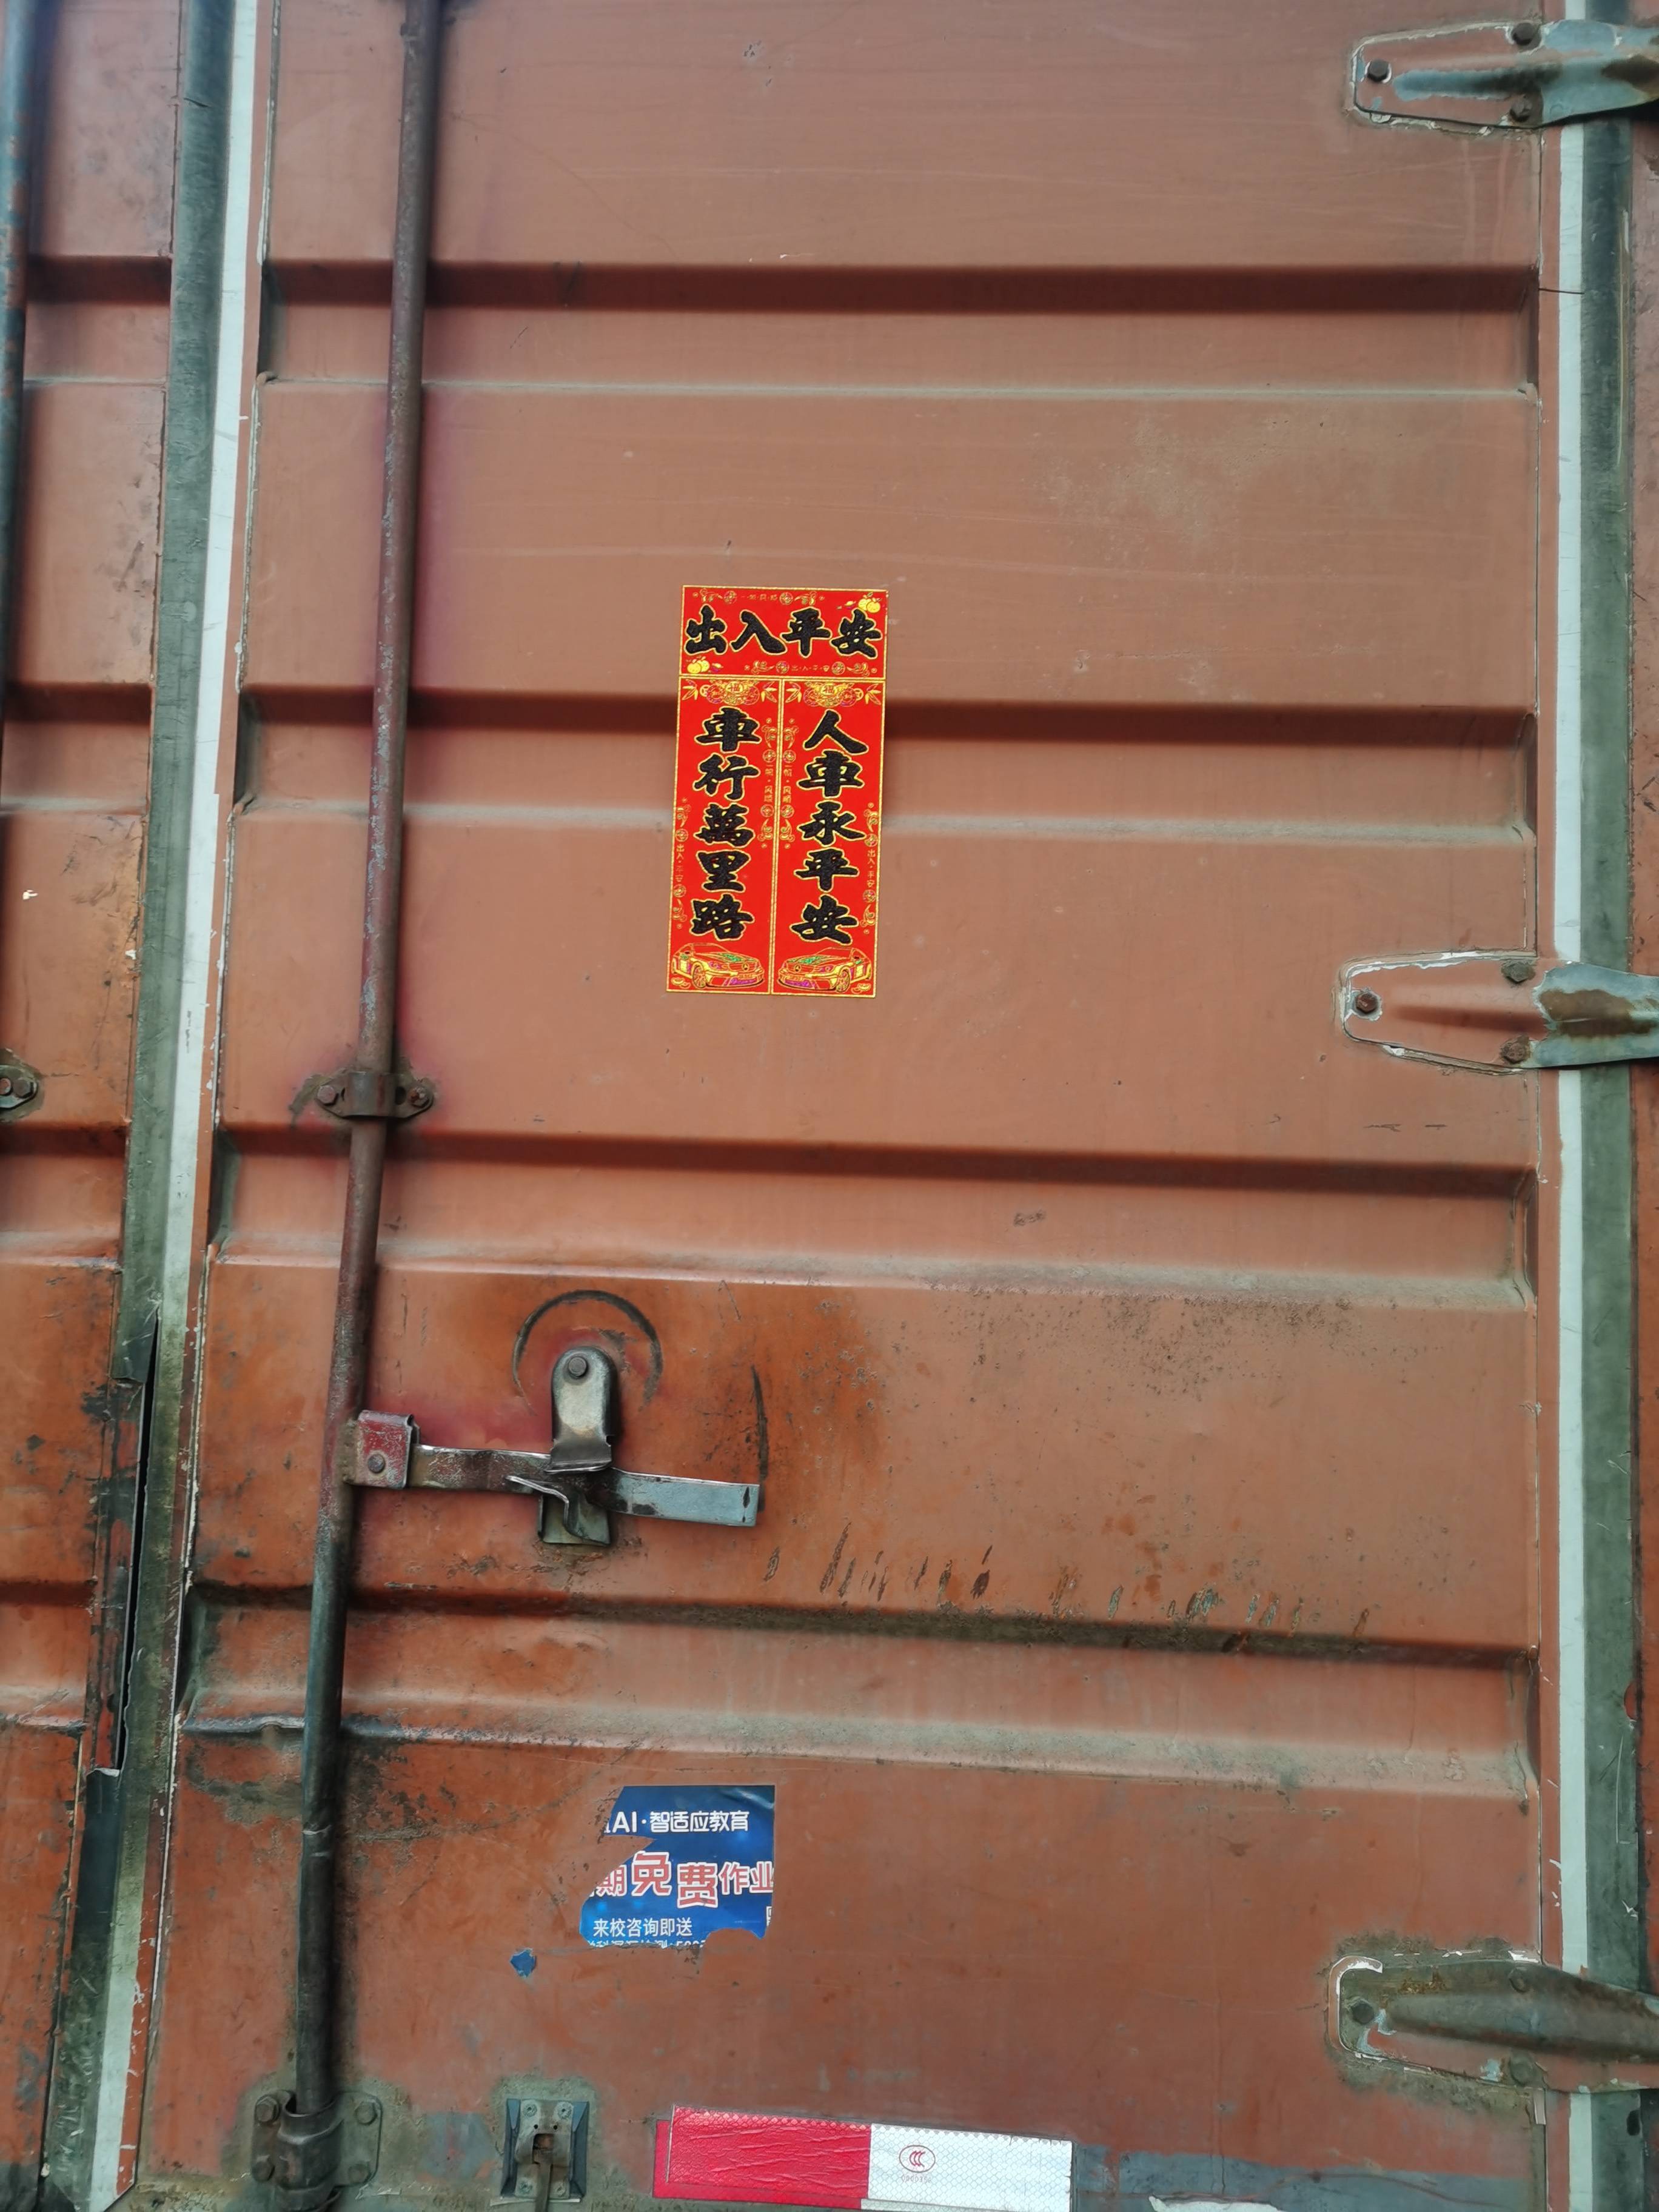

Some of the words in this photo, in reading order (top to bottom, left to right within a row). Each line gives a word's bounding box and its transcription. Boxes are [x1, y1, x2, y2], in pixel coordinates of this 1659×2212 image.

[684, 604, 883, 659] 出入平安
[689, 706, 762, 942] 車行萬里路
[789, 708, 870, 945] 人車永平安
[593, 1917, 692, 1937] 来校咨询即送
